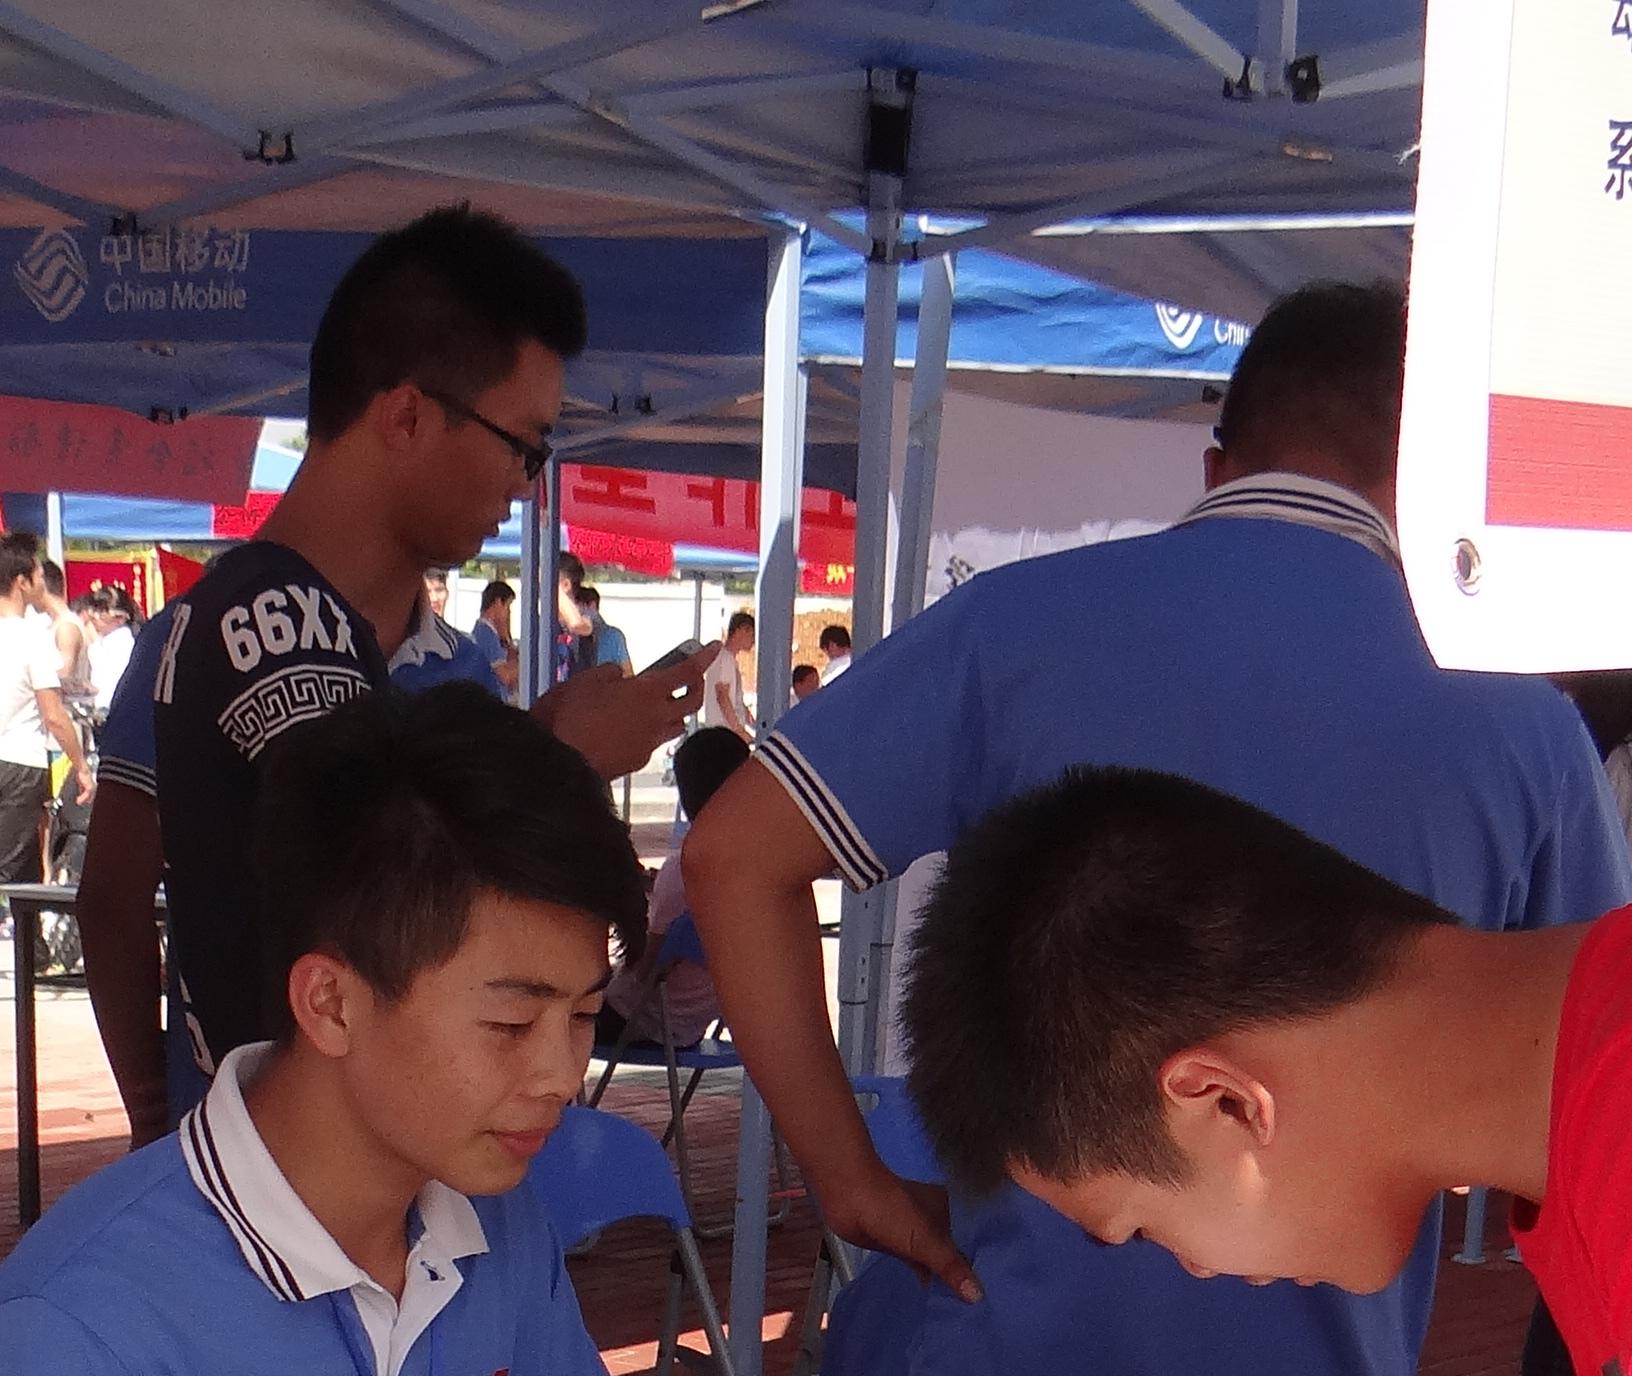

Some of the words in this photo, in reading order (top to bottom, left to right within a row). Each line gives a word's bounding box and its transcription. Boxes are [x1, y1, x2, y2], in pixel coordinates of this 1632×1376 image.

[100, 229, 250, 276] 中国移动
[105, 280, 166, 313] China
[171, 278, 248, 312] Mobile
[220, 585, 358, 674] 66XX
